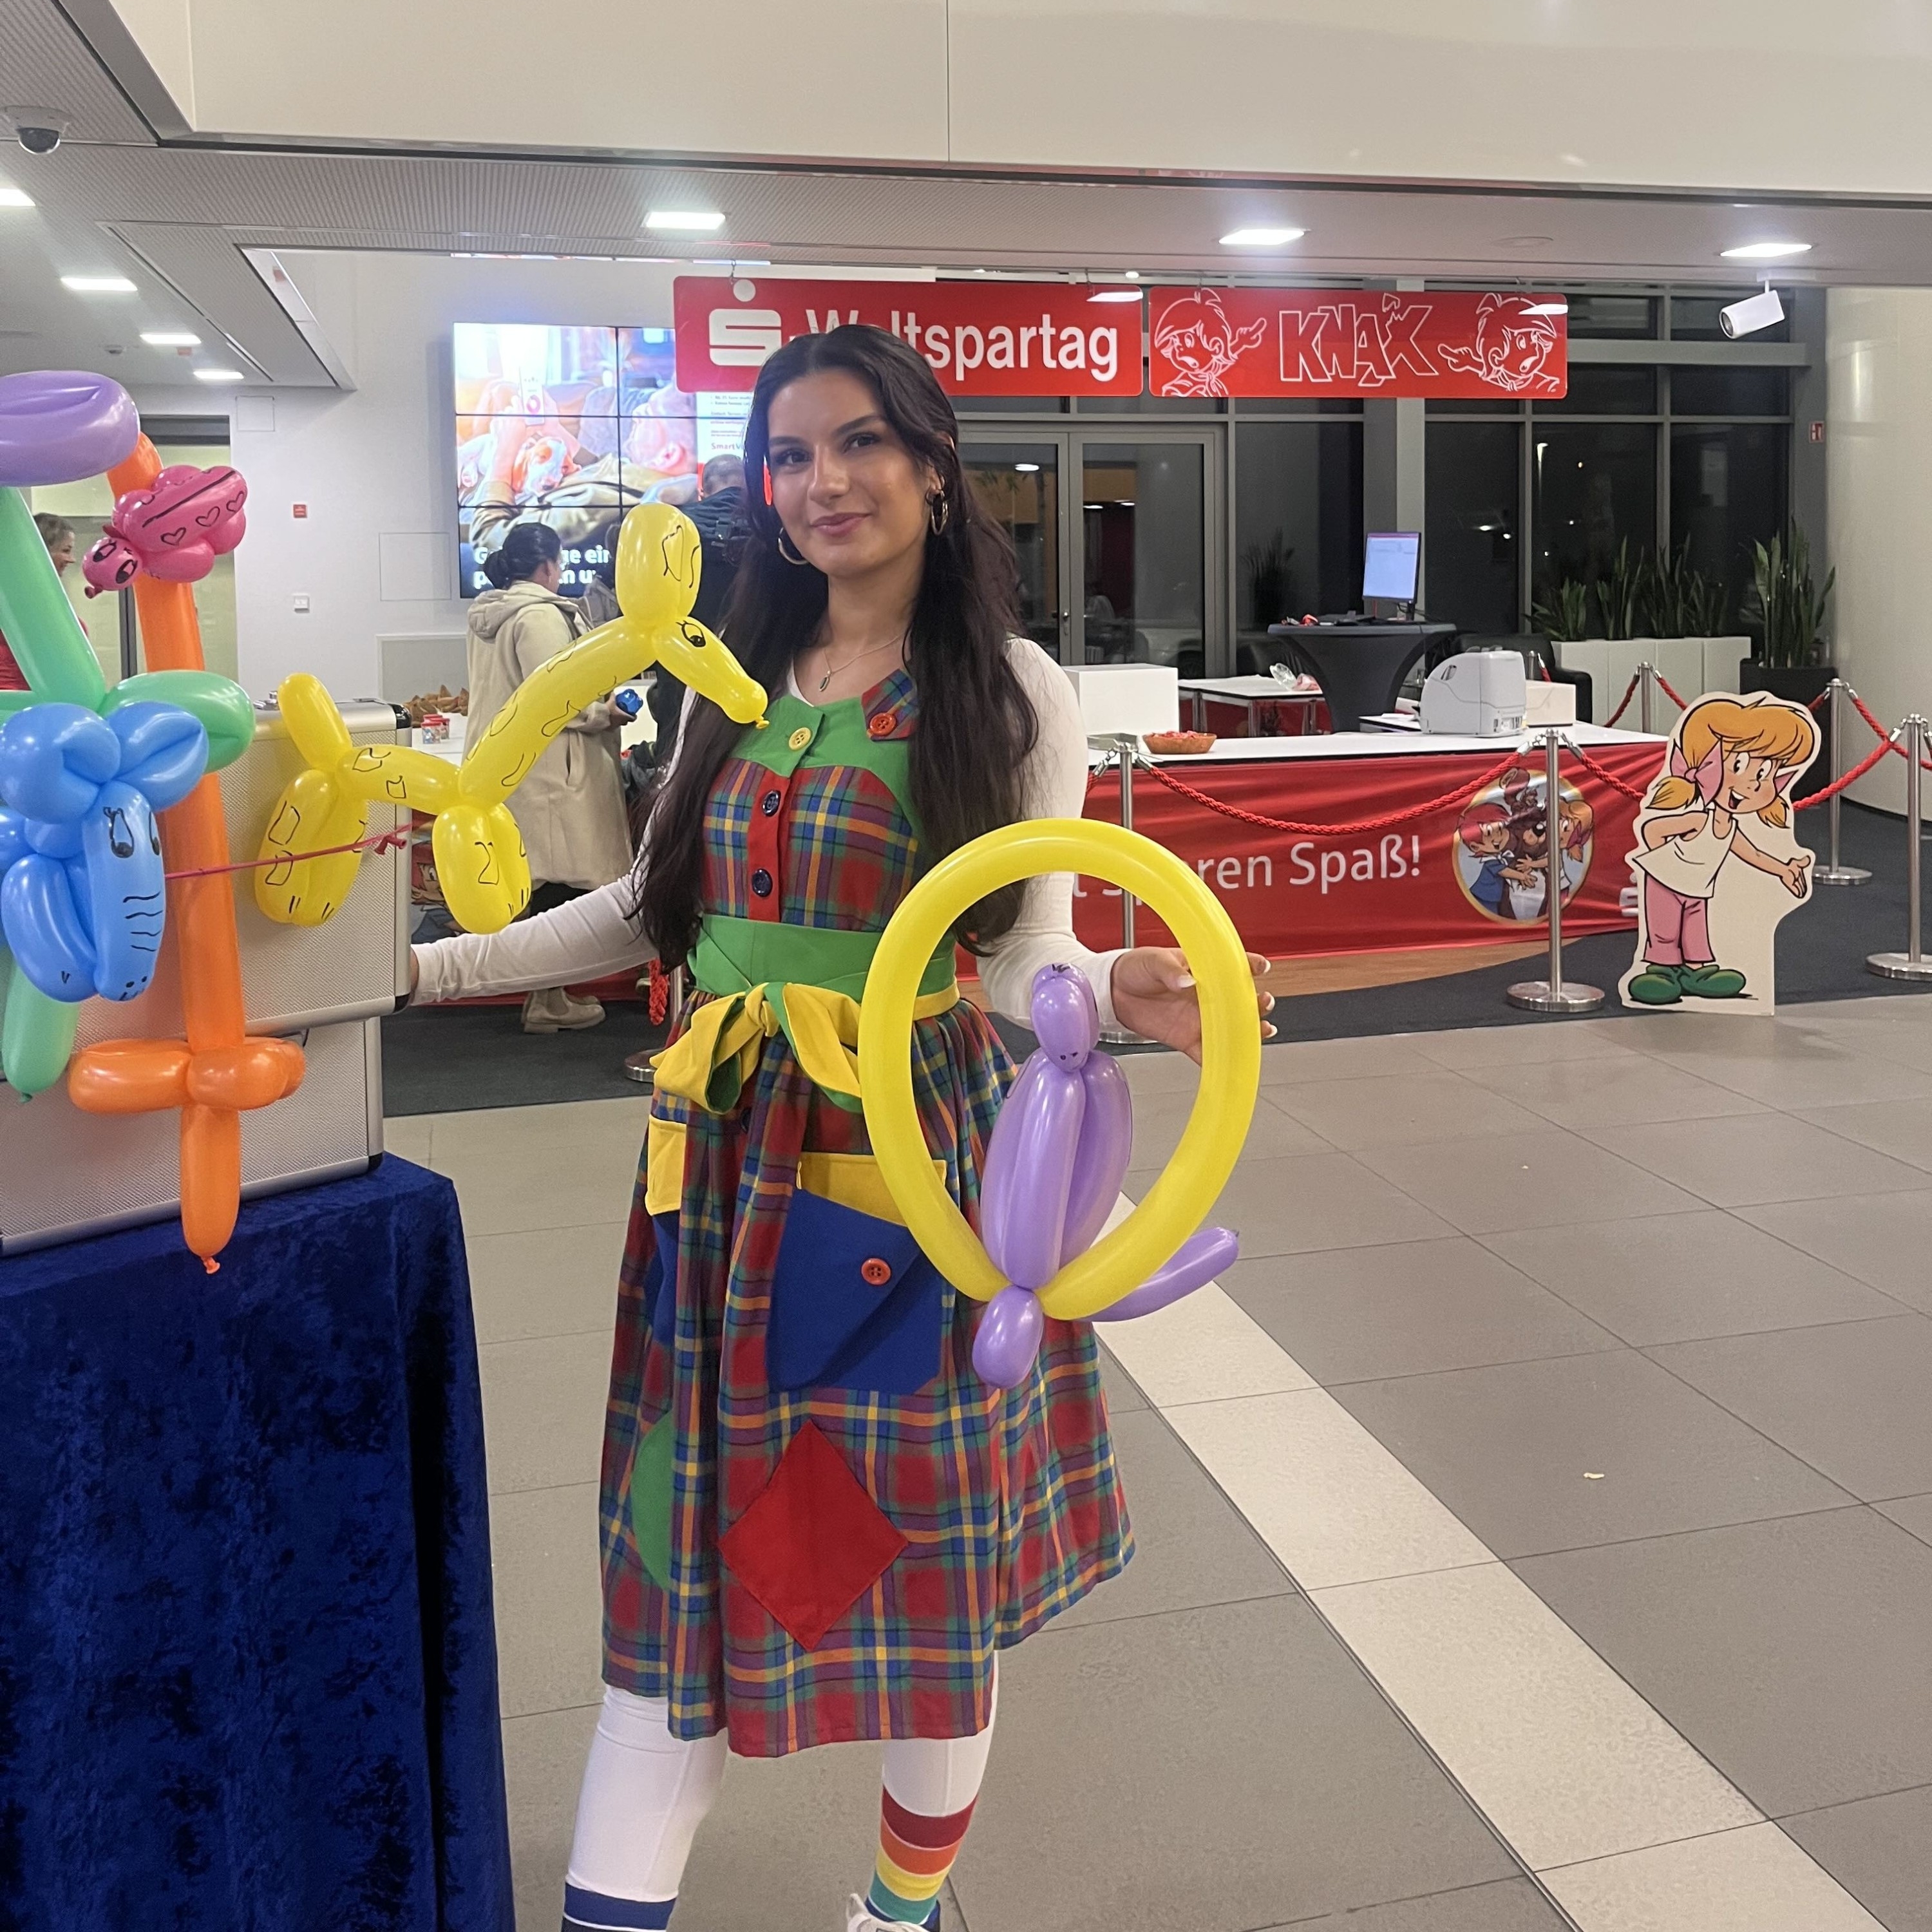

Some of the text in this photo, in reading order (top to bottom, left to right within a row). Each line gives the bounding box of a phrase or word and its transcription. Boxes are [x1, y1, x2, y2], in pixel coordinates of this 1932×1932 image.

[806, 308, 1117, 381] tspartag
[1279, 293, 1439, 386] KNAX
[1289, 833, 1419, 894] Spaß!
